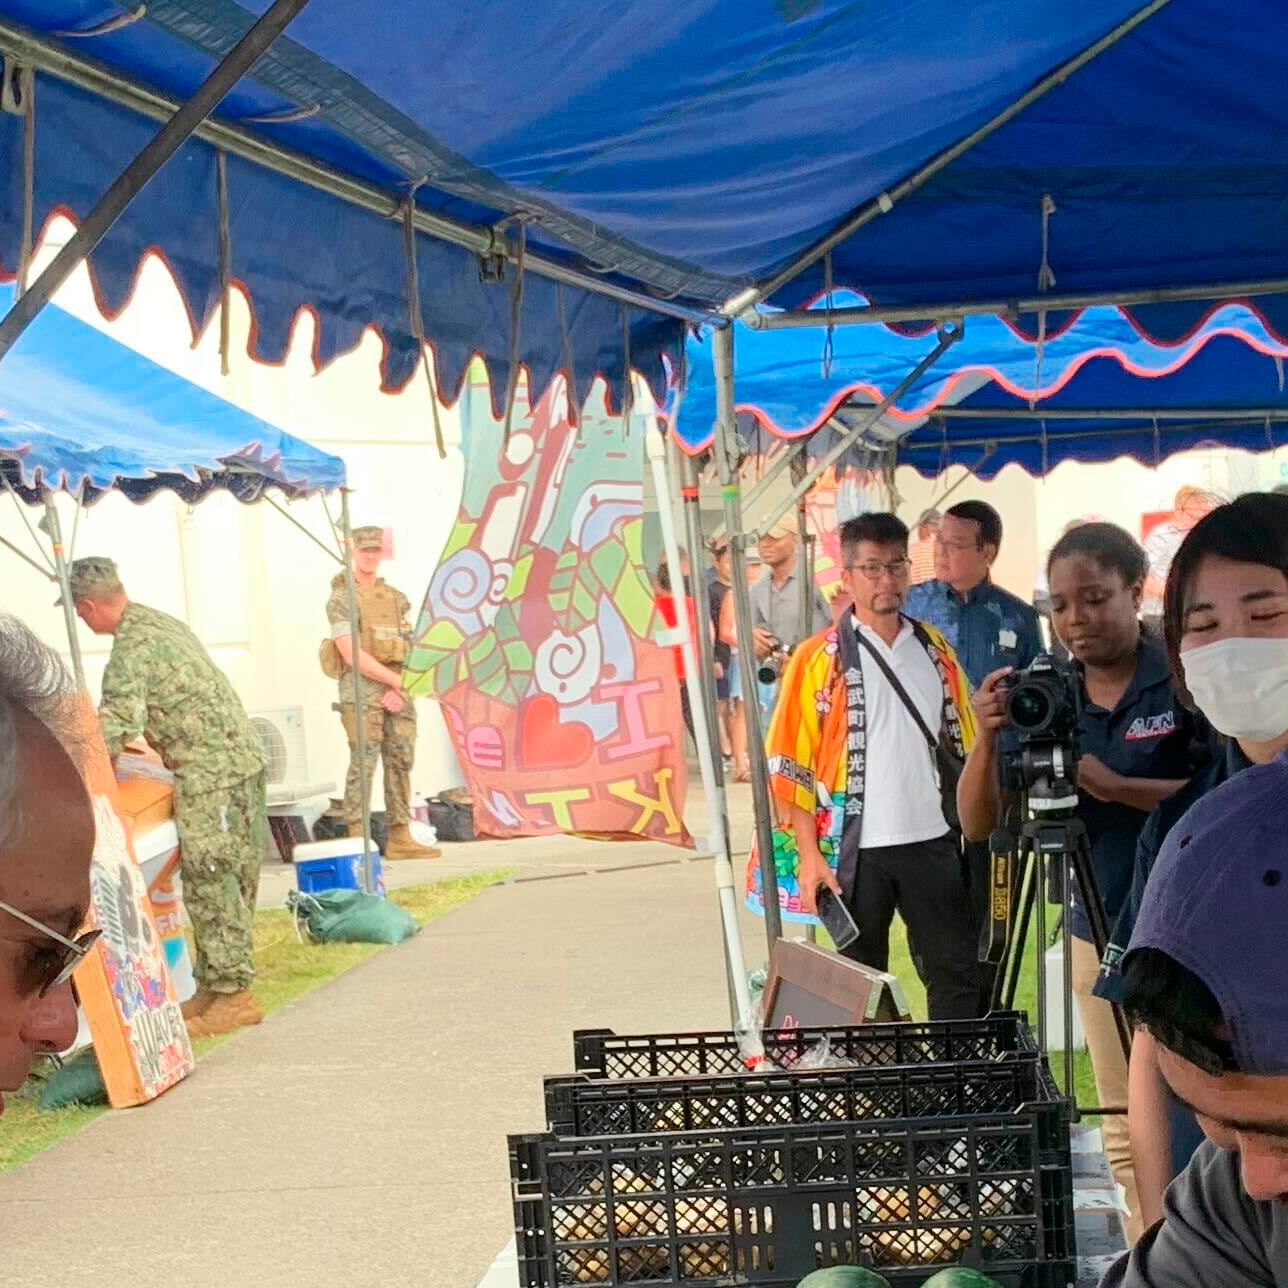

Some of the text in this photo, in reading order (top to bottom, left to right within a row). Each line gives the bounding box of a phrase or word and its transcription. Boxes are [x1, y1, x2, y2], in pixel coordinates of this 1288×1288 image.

[843, 667, 867, 816] 金武町観光協会
